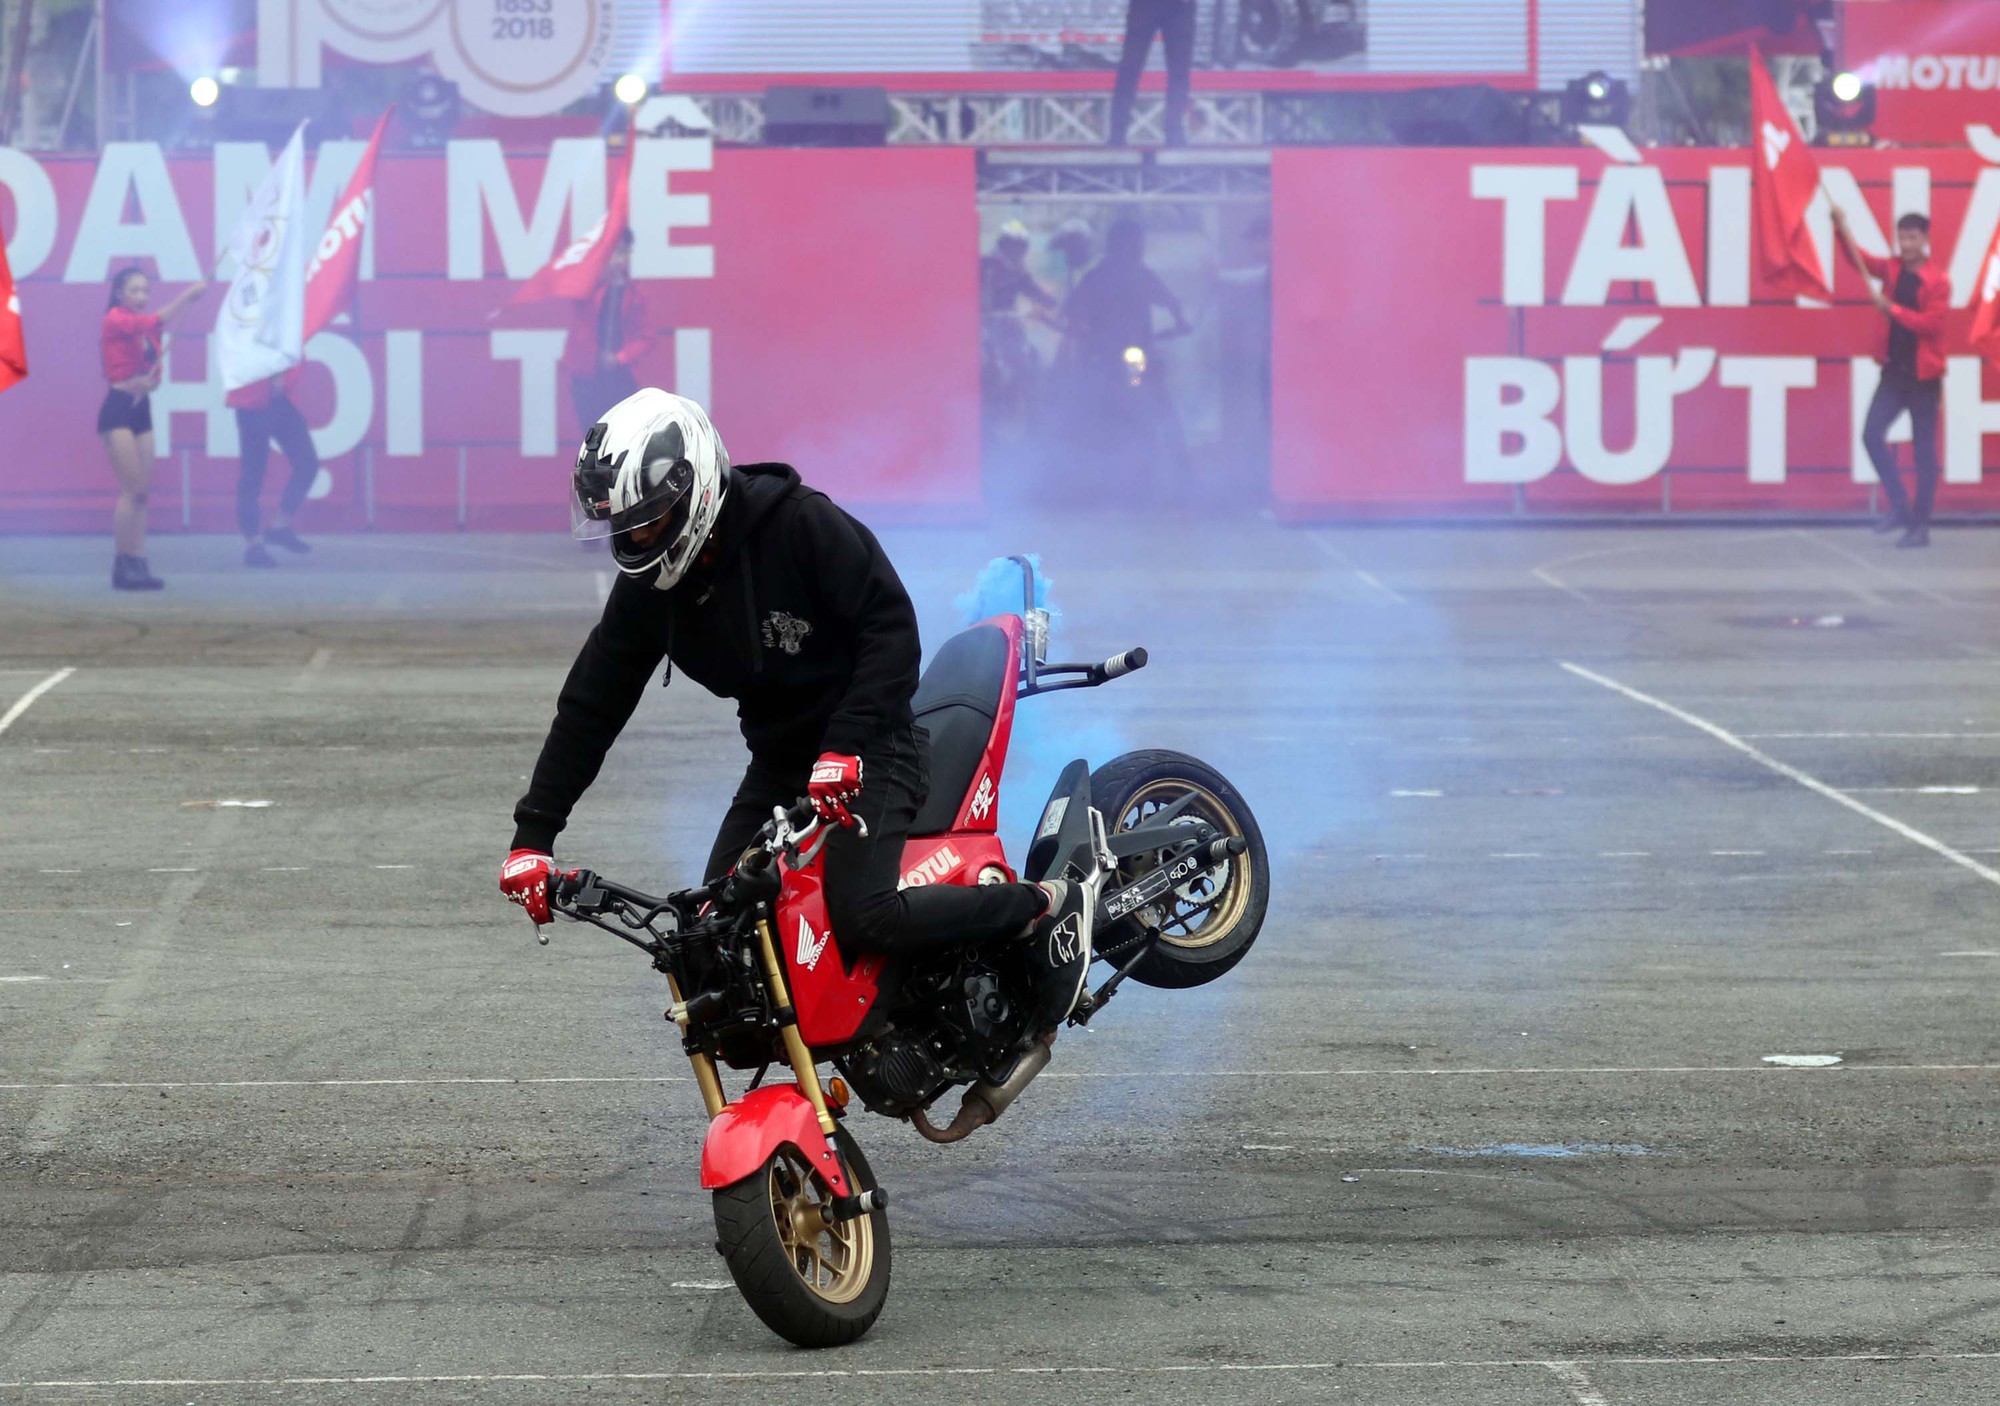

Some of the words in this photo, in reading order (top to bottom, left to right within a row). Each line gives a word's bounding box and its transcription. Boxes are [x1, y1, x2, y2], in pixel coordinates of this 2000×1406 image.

[493, 17, 555, 39] 2018
[1873, 53, 2000, 91] MOTU
[1470, 124, 1752, 308] TÀI
[1463, 315, 1818, 485] BỨT
[807, 930, 831, 972] HONDA
